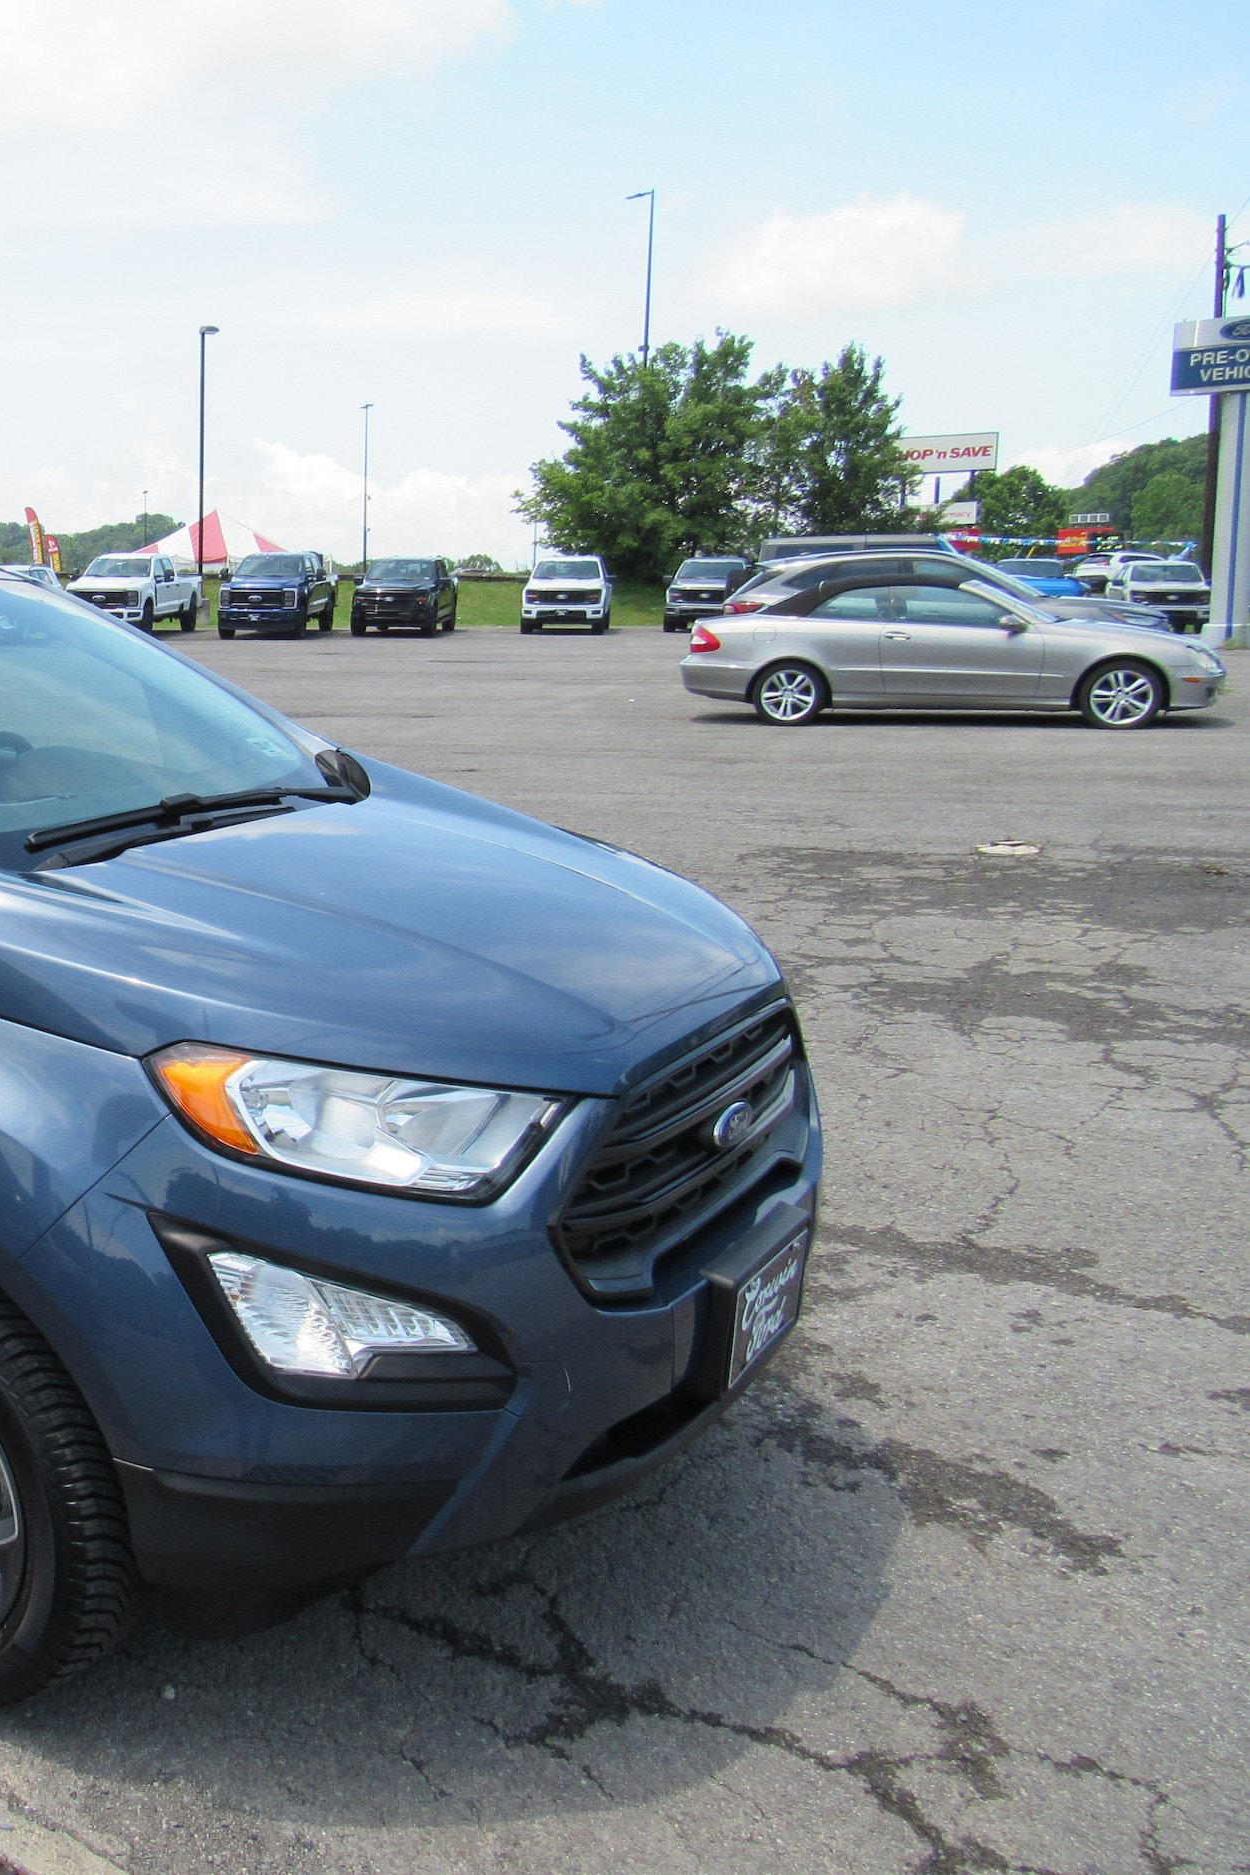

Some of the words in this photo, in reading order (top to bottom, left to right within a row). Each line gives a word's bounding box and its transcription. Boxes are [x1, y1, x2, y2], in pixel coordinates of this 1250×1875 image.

[903, 449, 934, 461] HOP
[950, 446, 993, 458] SAVE
[940, 511, 971, 519] armacy
